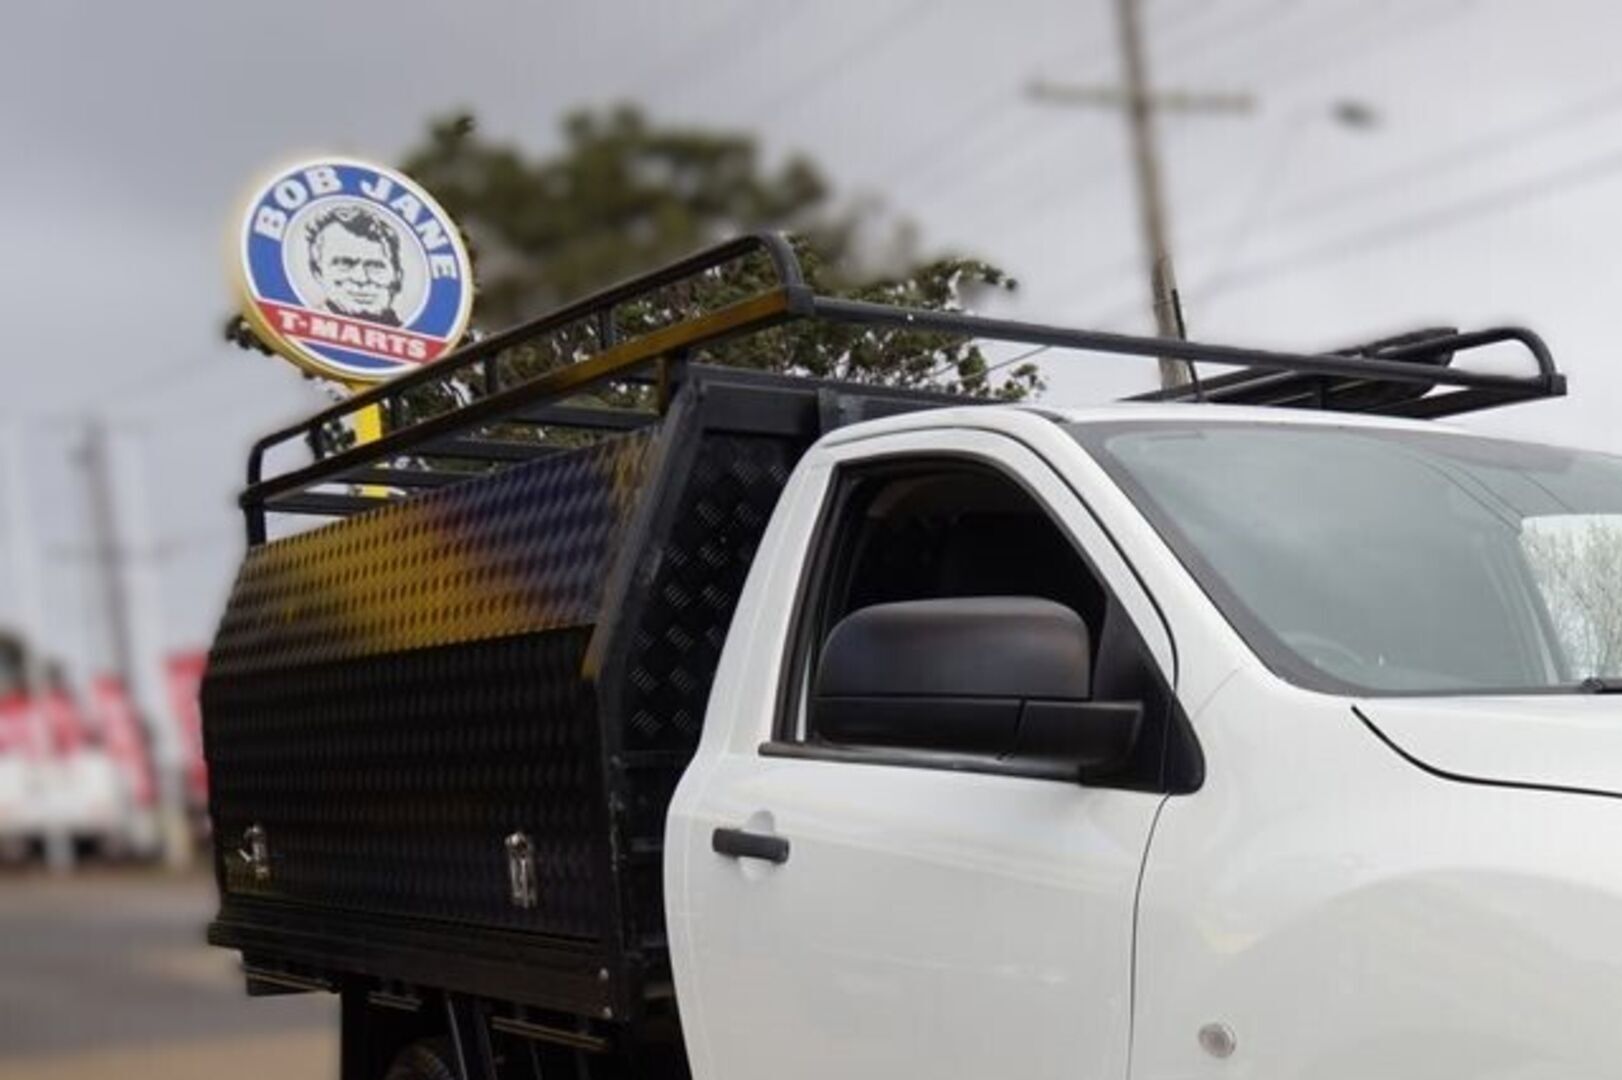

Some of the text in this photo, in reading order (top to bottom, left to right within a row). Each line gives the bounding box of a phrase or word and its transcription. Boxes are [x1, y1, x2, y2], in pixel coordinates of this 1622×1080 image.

[253, 166, 457, 280] BOB JANE
[278, 310, 427, 359] T-MARTS
